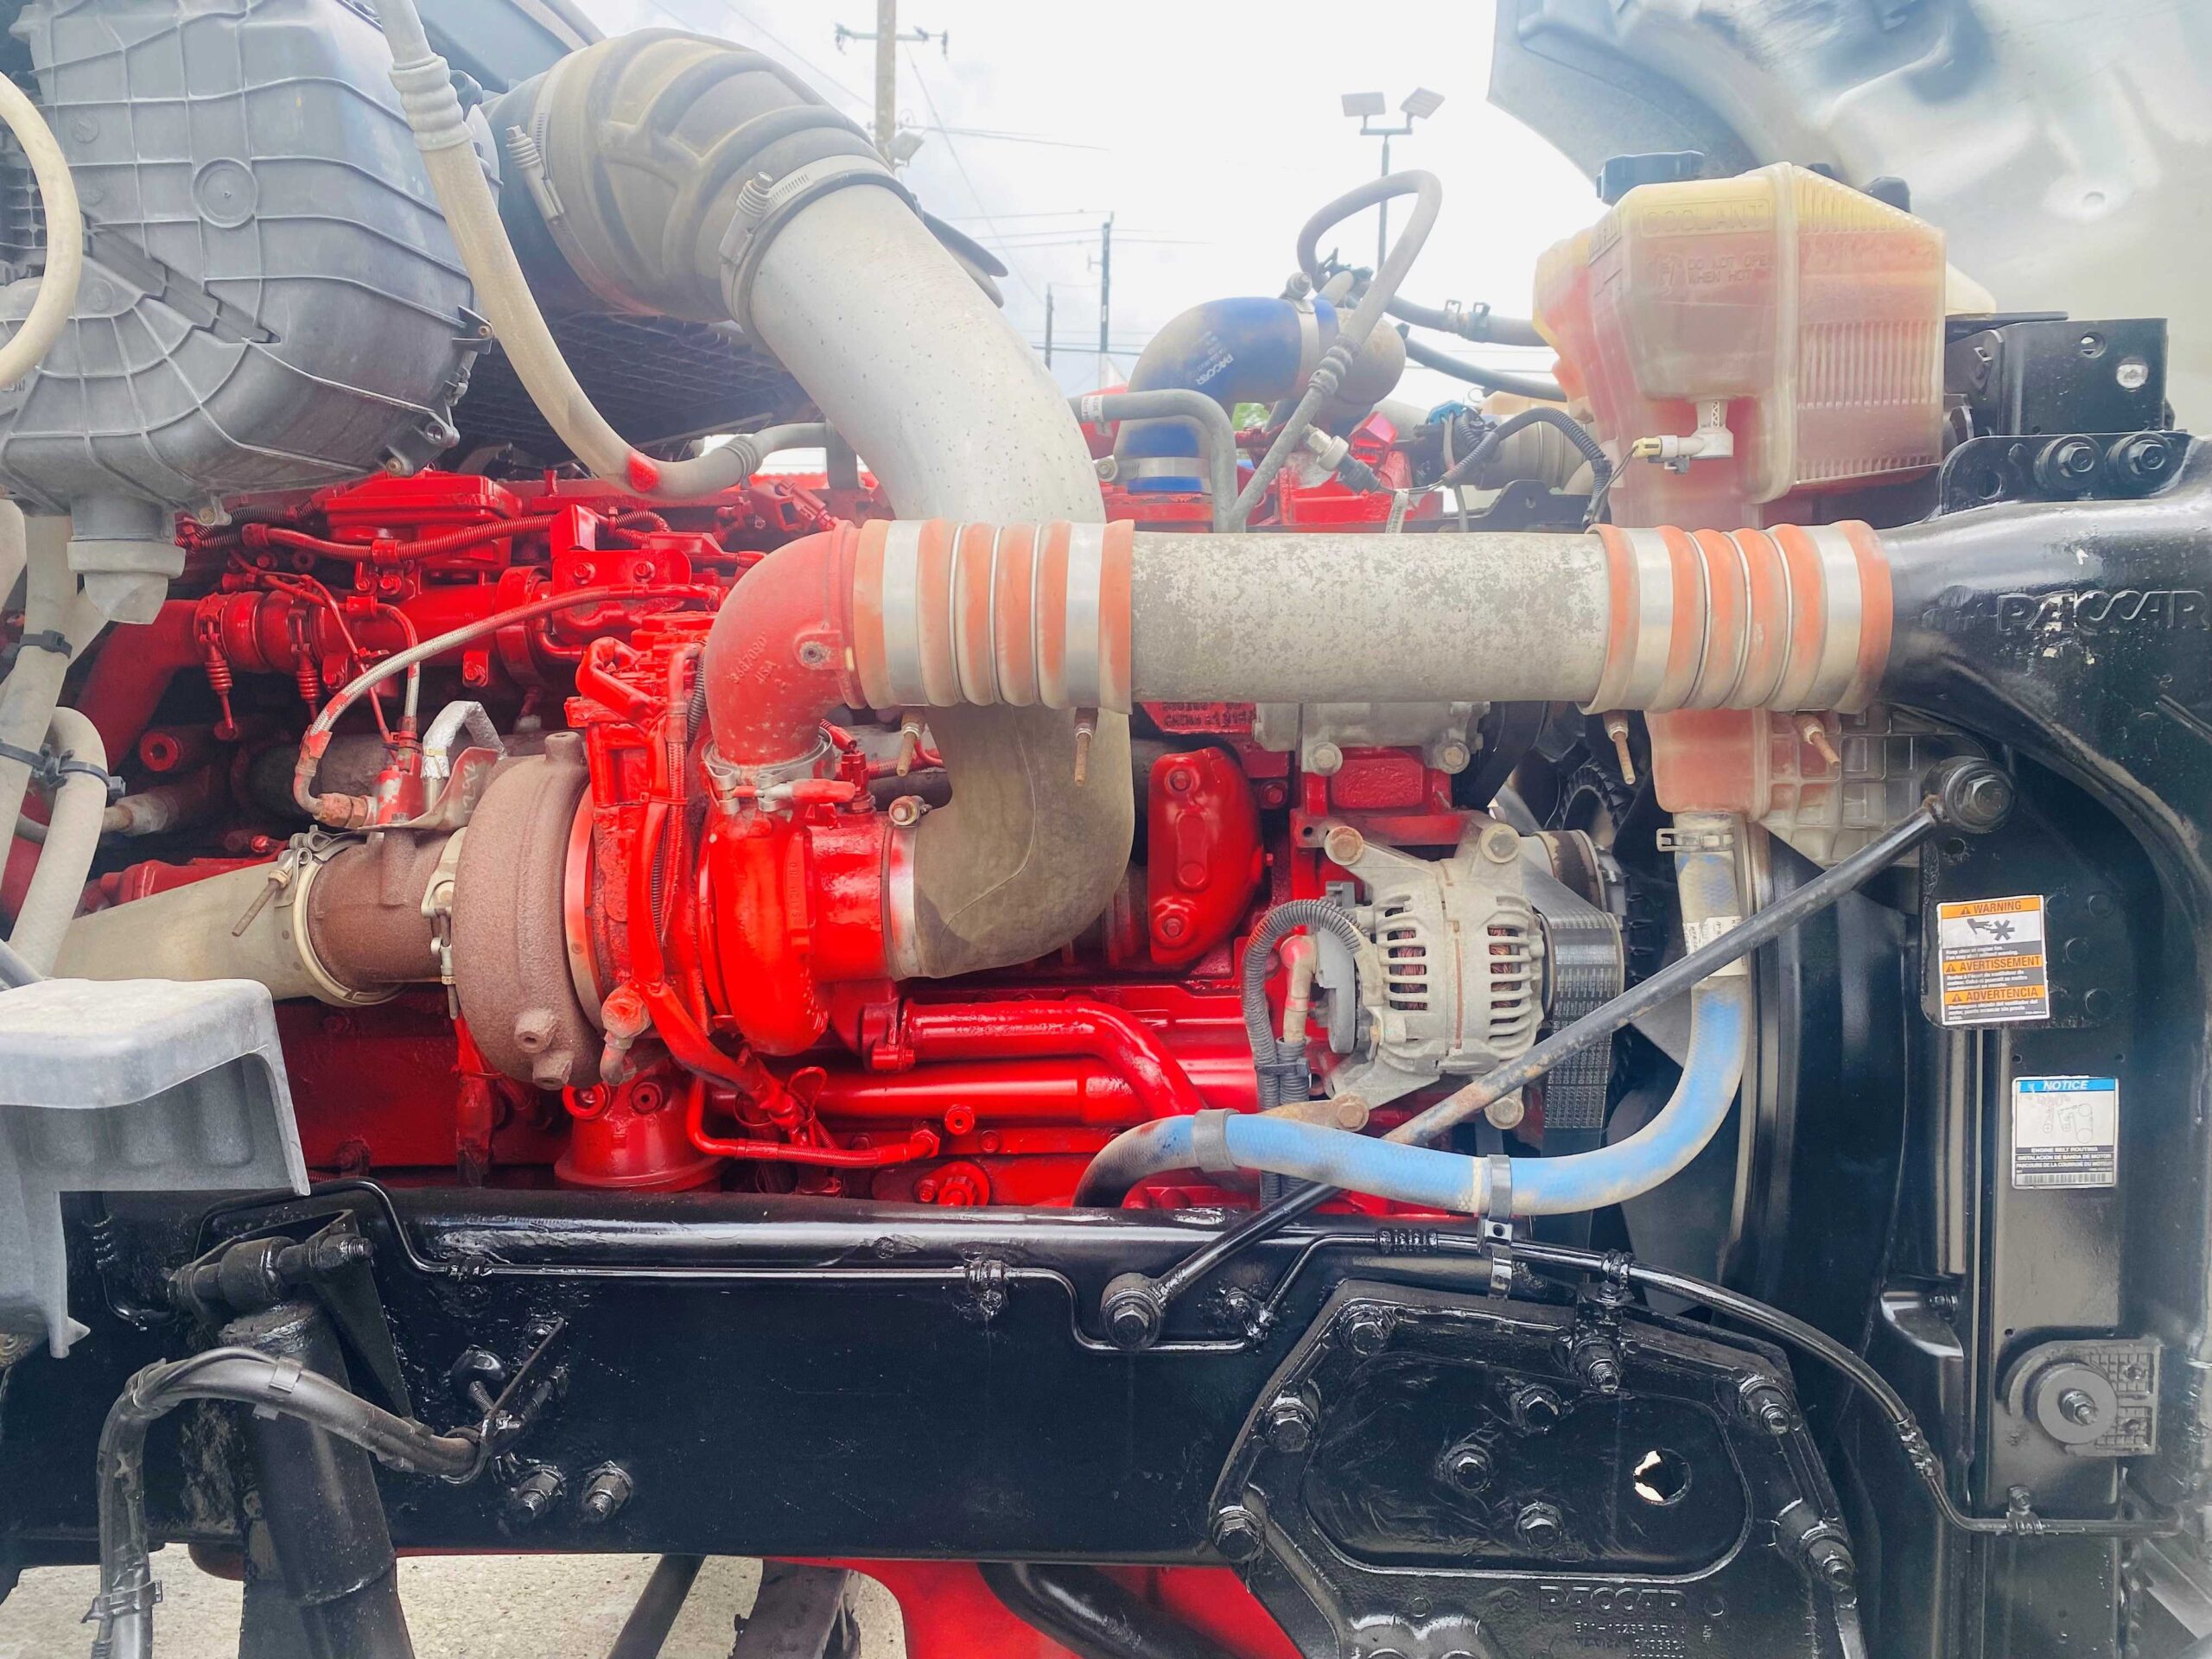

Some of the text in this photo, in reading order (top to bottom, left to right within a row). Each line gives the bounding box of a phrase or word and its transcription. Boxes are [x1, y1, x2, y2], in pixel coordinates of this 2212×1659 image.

[1646, 204, 1764, 232] COOLANT
[1998, 588, 2209, 635] PACCAR
[1974, 900, 2022, 914] WARNING
[1960, 956, 2040, 971] AVERTISSEMENT
[1966, 987, 2038, 1001] ADVERTENCIA
[2043, 1080, 2089, 1090] NOTICE
[1540, 1586, 1687, 1621] PACCAR
